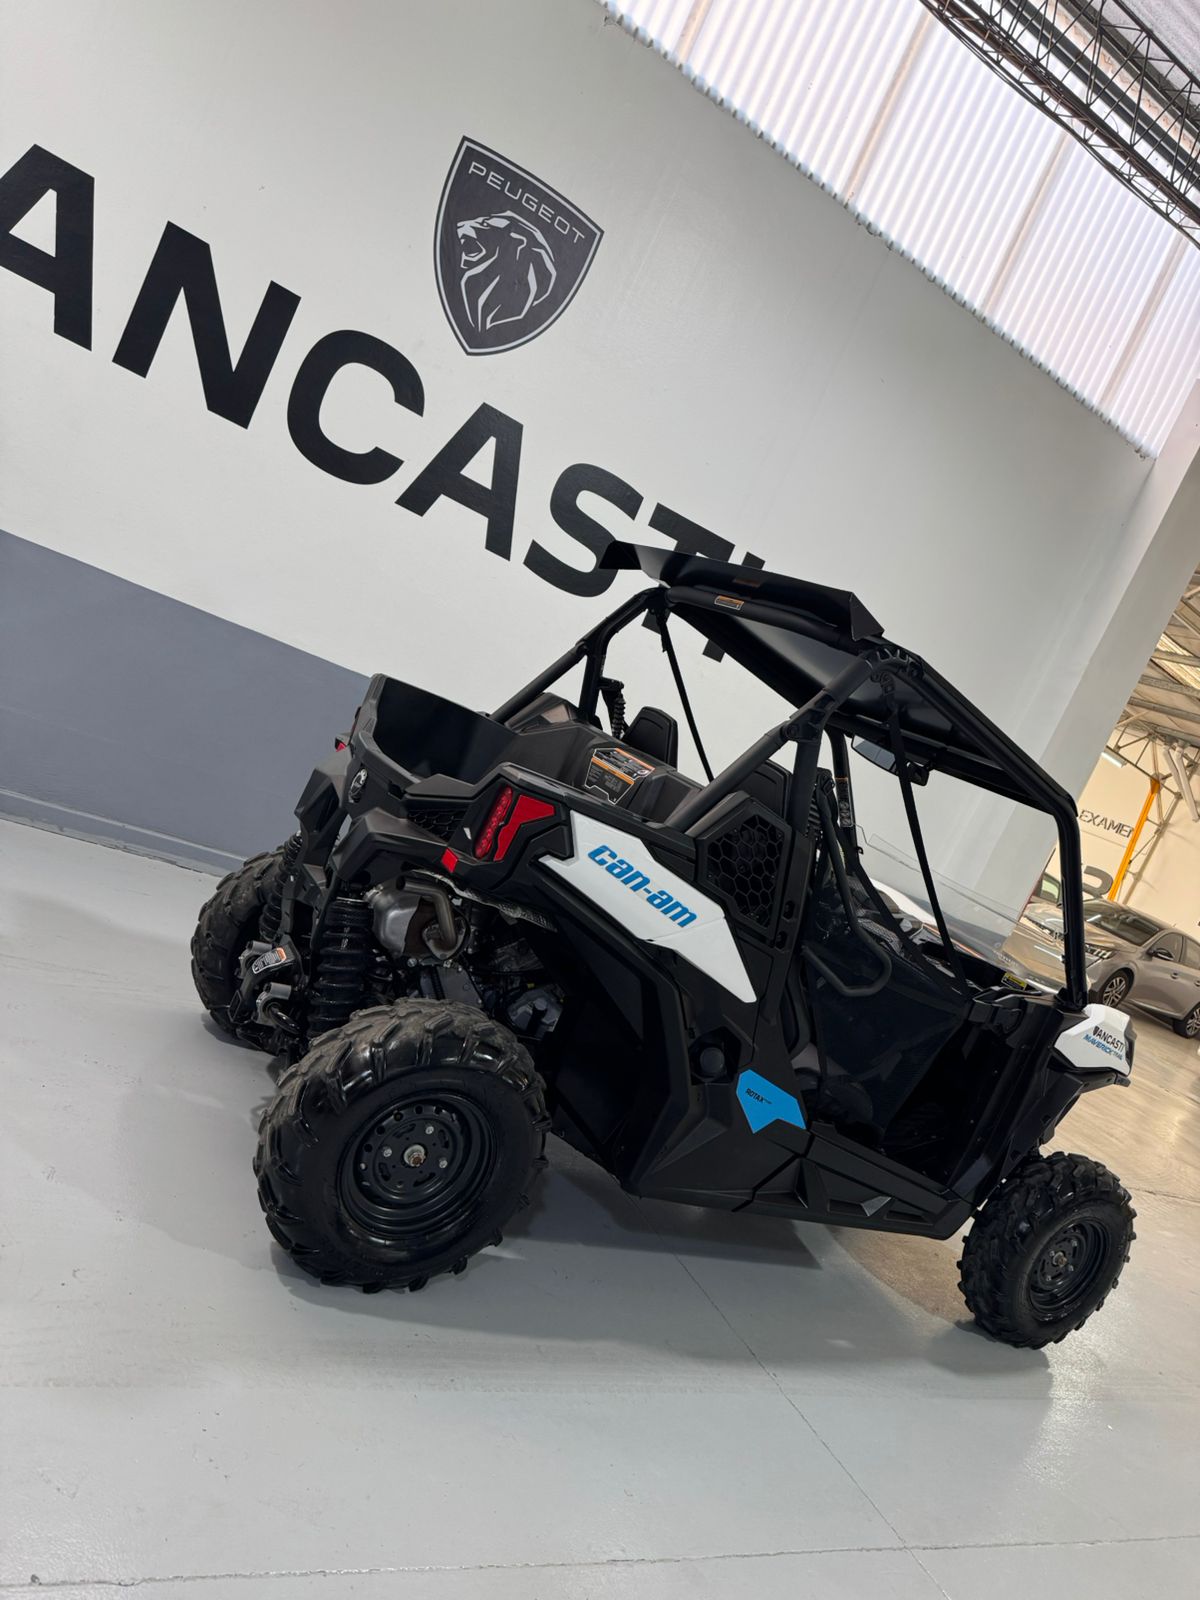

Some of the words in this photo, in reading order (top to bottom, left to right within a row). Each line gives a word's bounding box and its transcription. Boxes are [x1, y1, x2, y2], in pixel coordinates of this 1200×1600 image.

[468, 161, 585, 243] PEUGEOT
[0, 143, 765, 663] ANCAST
[587, 844, 697, 928] can-am
[745, 1087, 764, 1104] ROTAX
